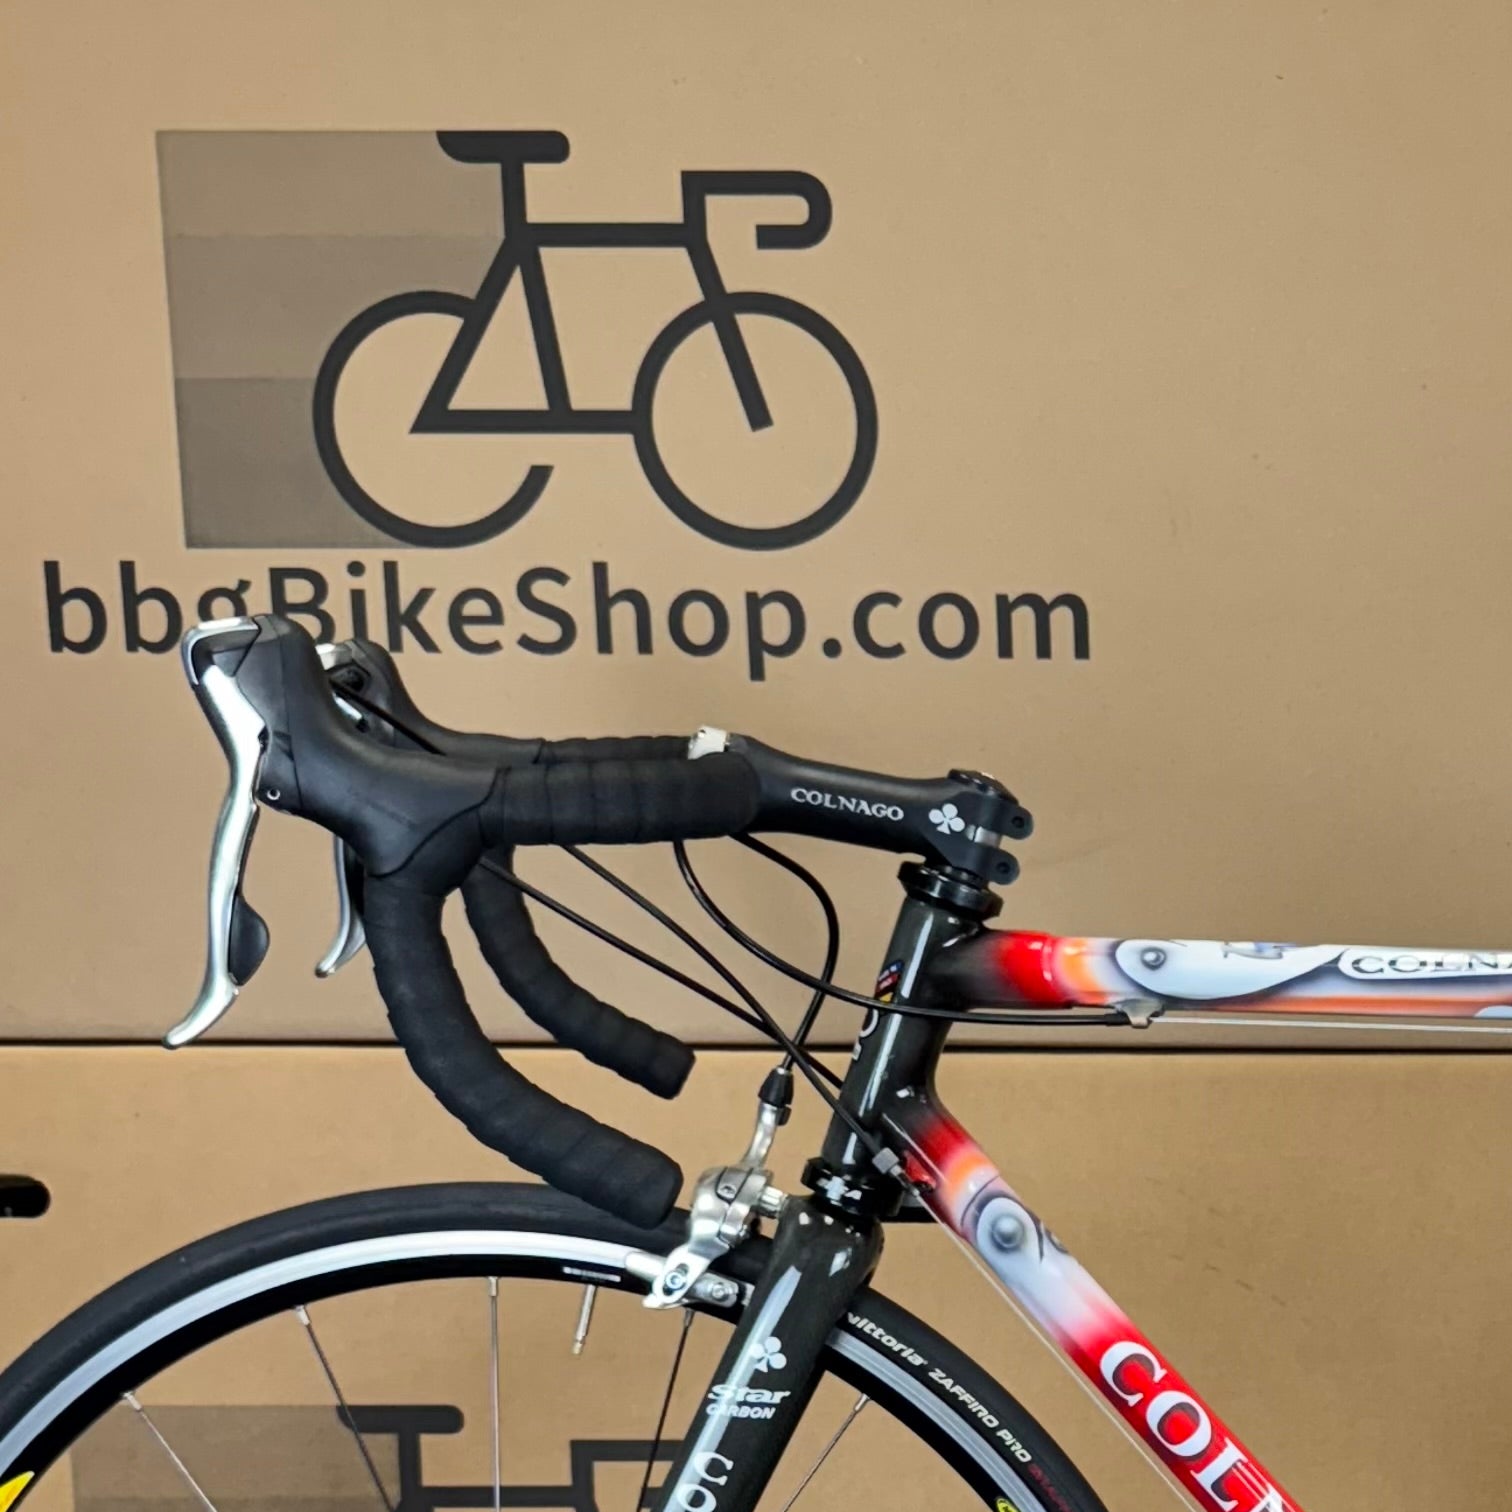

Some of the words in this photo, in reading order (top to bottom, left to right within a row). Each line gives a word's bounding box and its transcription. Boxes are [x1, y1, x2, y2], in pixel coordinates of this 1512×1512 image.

[790, 787, 905, 822] COLNAGO
[848, 1312, 924, 1367] vittoria
[928, 1367, 999, 1428] ZAFFIRO
[996, 1429, 1032, 1464] PRO
[706, 1404, 776, 1420] CARBON
